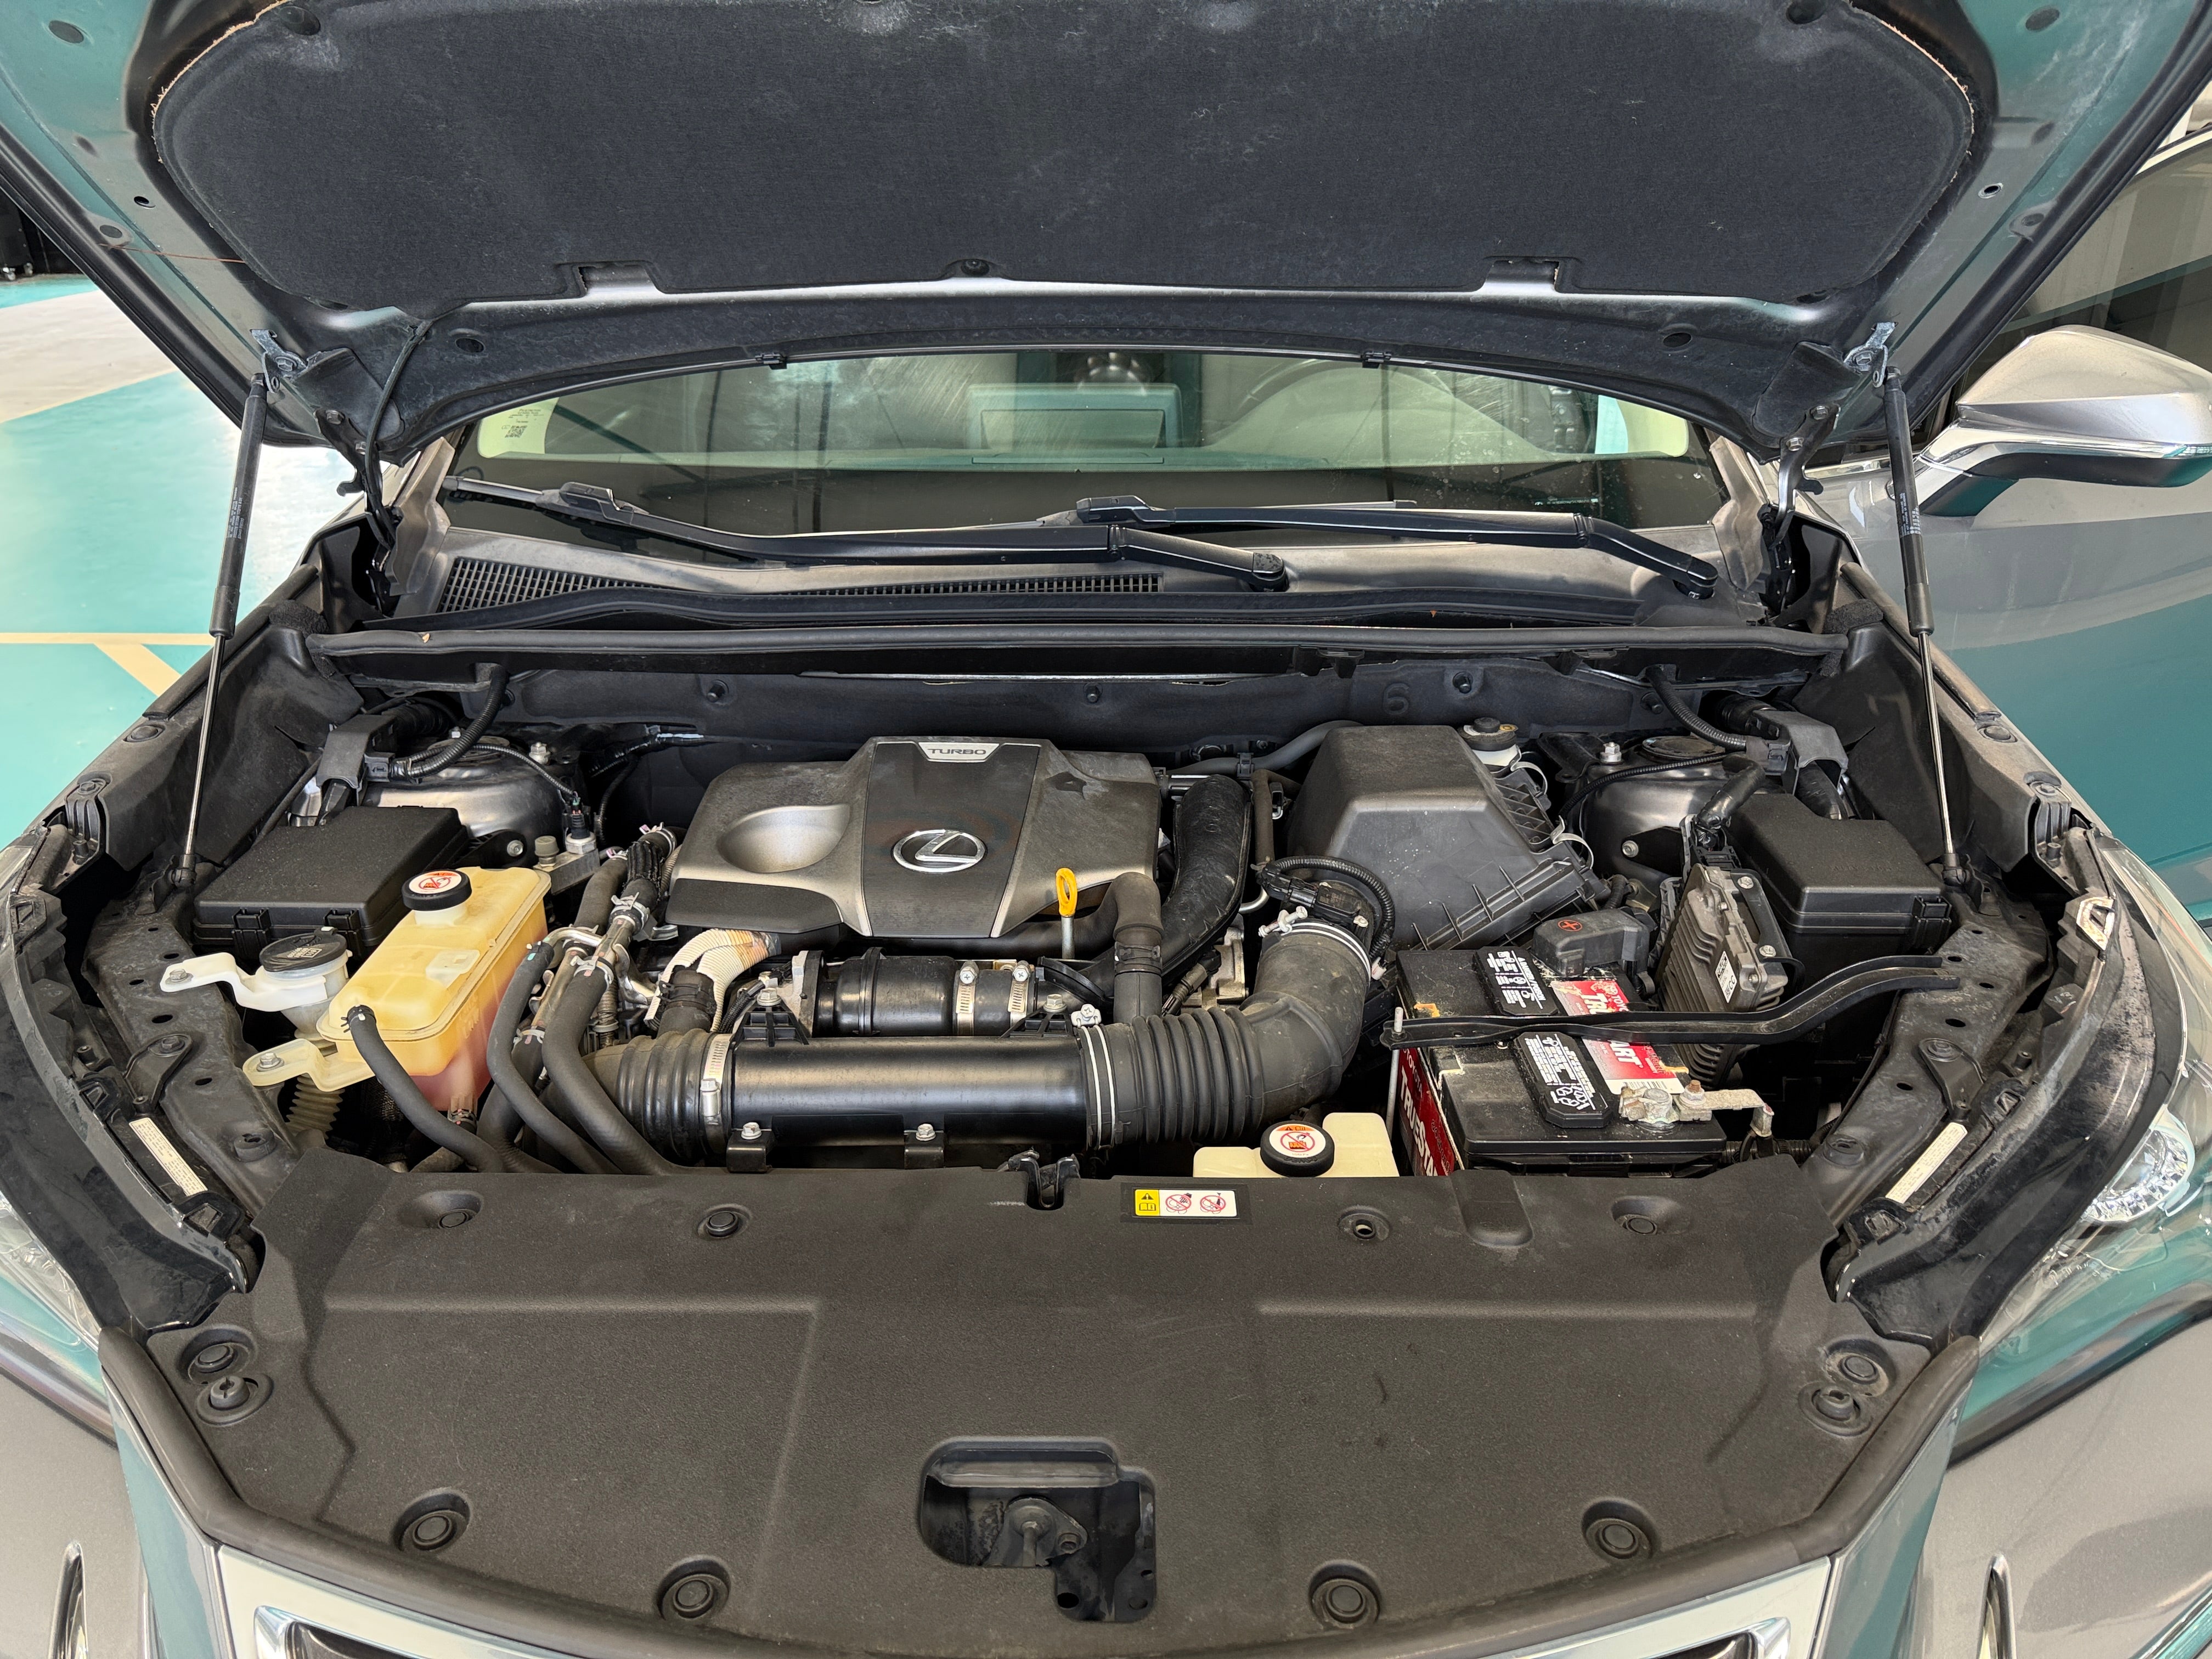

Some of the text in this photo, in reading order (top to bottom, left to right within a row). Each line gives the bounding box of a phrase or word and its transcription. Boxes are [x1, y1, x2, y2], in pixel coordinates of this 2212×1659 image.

[1611, 995, 1629, 1012] TOYO
[1406, 1048, 1423, 1098] TOYOTA
[1401, 1065, 1438, 1176] TRUESTA
